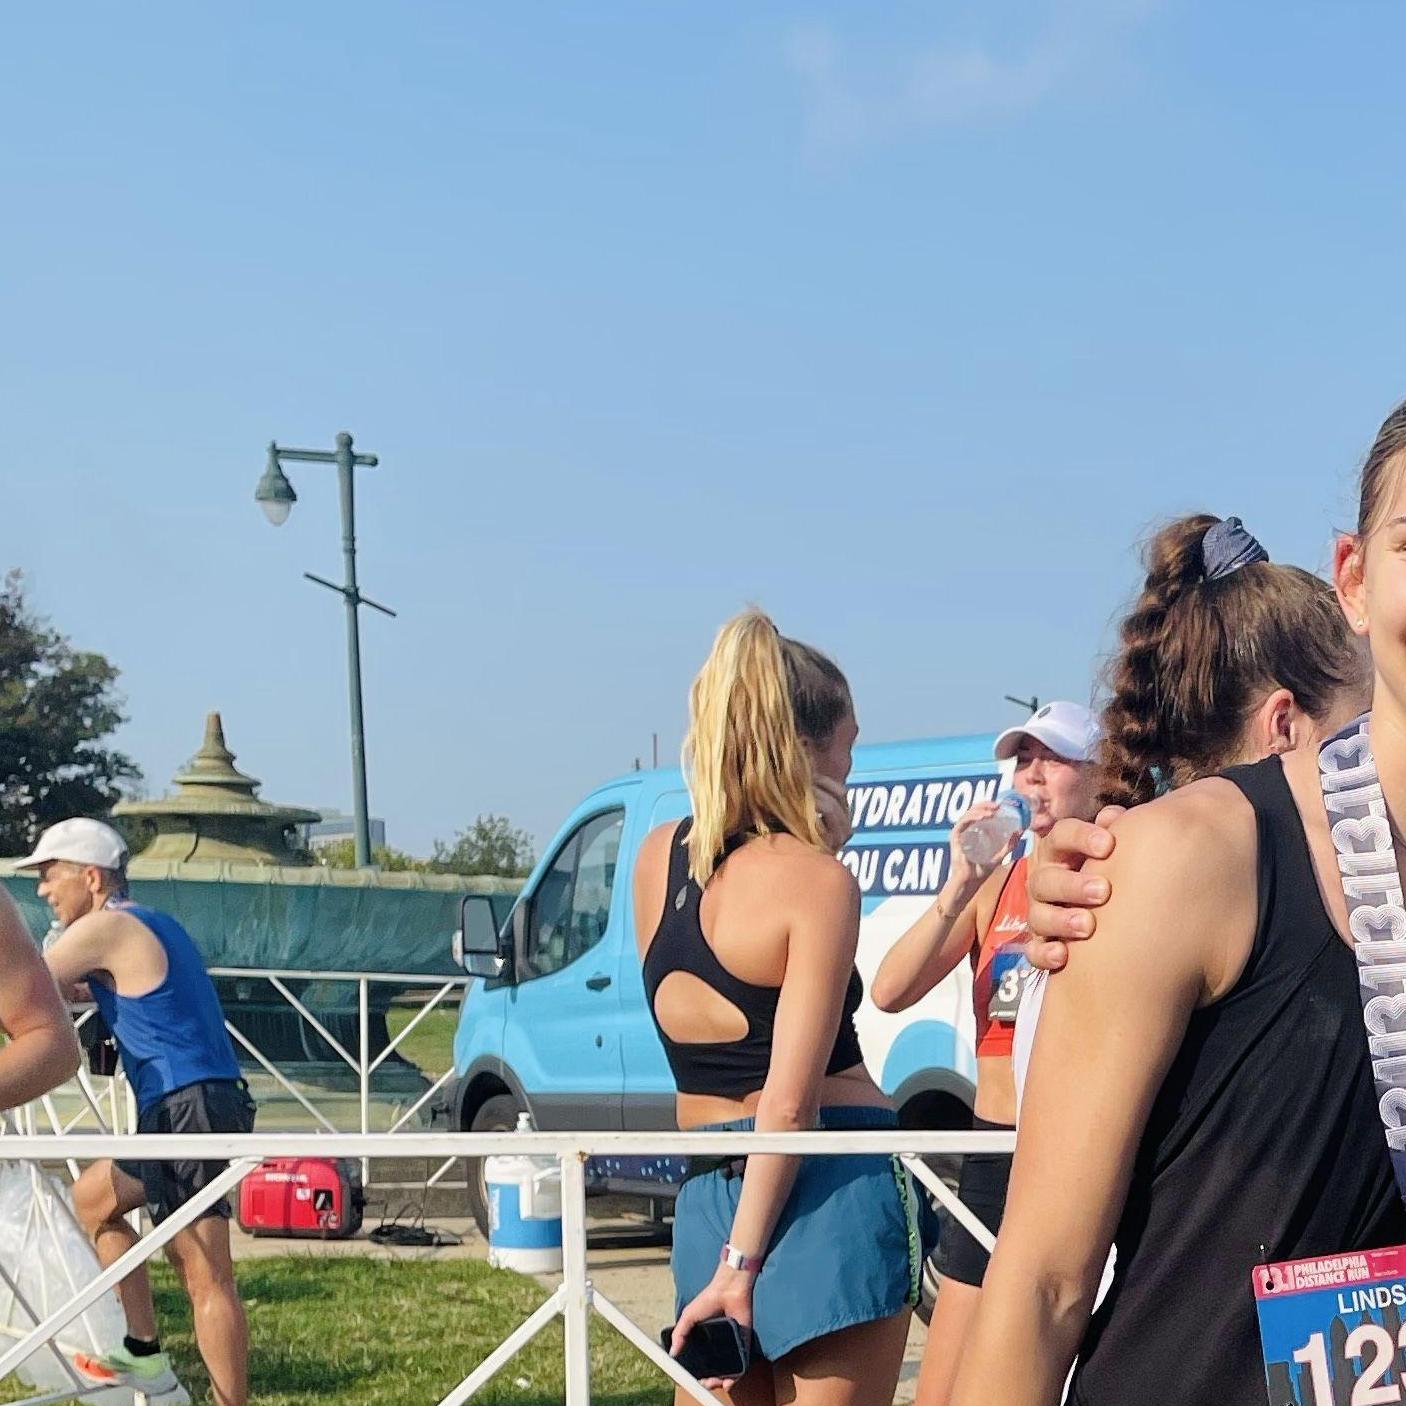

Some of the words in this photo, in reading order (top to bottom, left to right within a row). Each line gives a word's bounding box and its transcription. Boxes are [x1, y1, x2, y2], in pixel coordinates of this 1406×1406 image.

[847, 779, 997, 828] YDRATION
[836, 849, 880, 892] OU
[882, 847, 944, 892] CAN
[1294, 1254, 1368, 1277] PHILADELPHIA
[1295, 1269, 1346, 1290] DISTANCE
[1347, 1265, 1371, 1282] RUN
